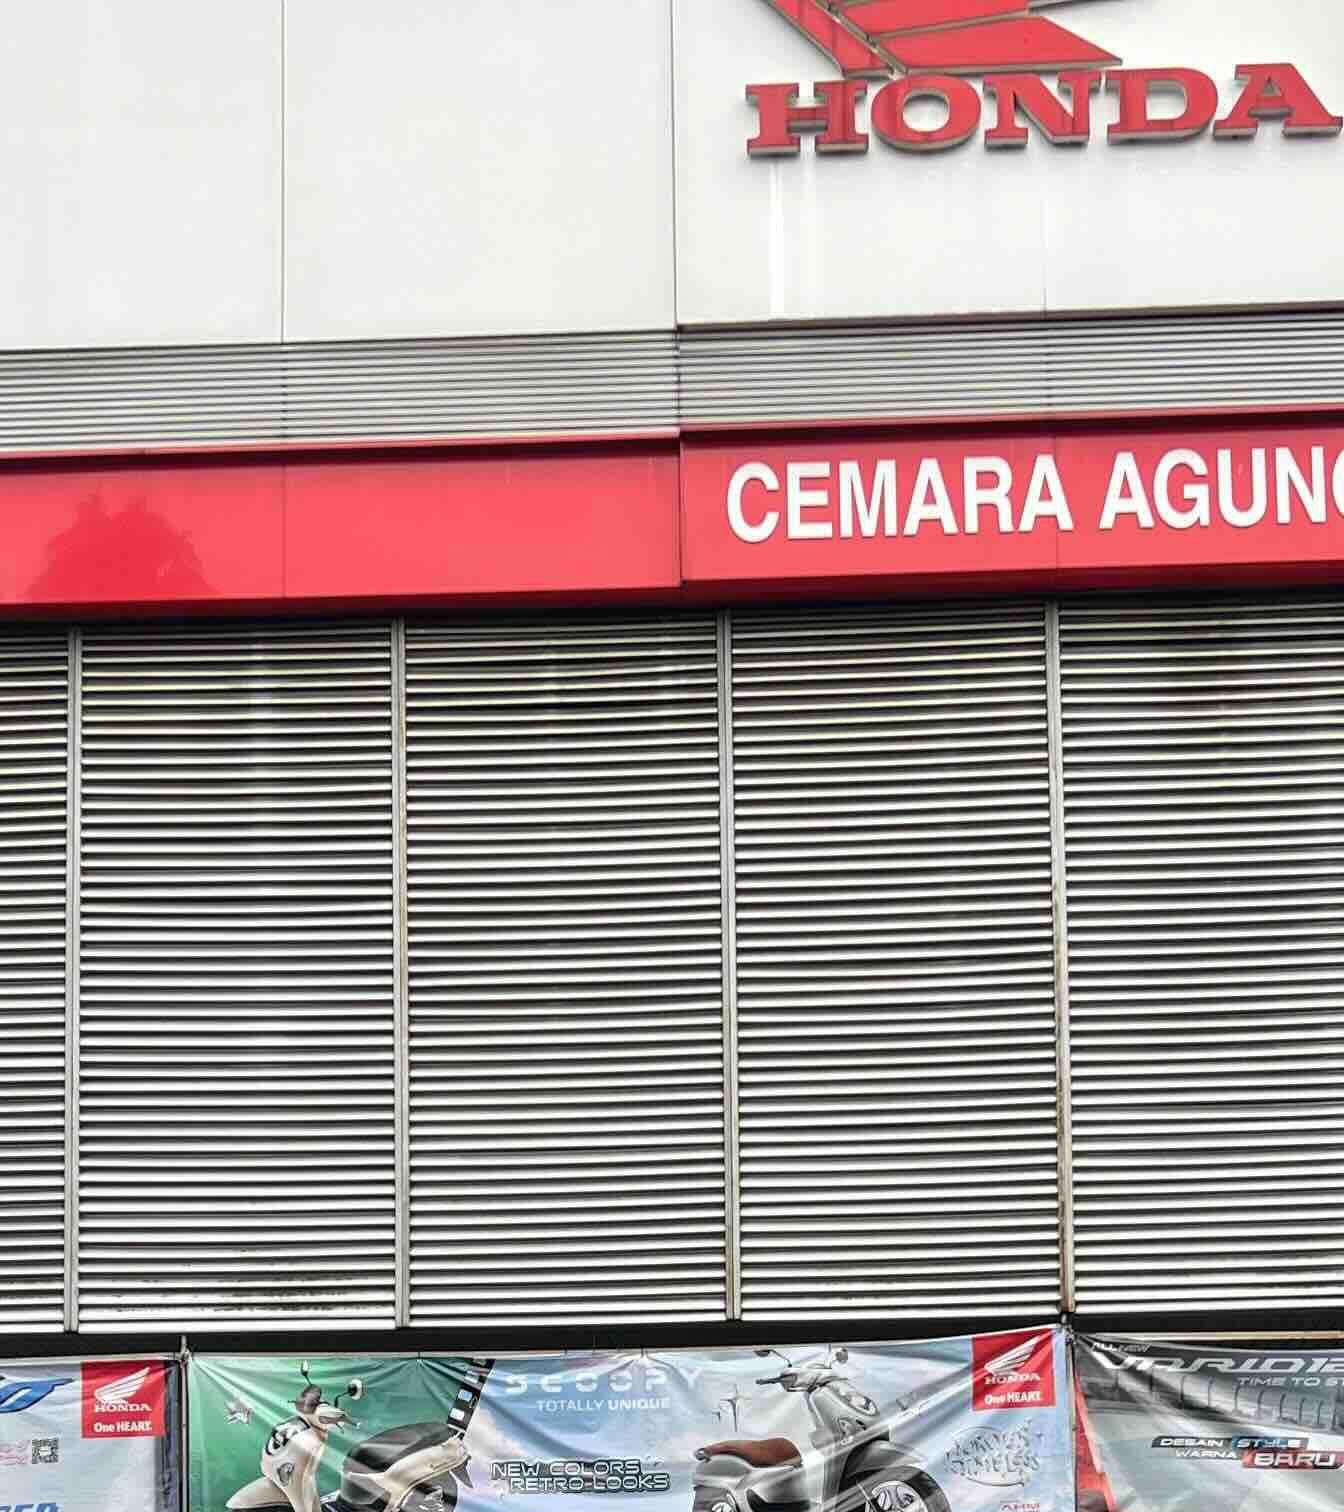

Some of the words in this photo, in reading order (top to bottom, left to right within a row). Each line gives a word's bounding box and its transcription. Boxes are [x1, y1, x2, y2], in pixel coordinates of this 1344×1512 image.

[745, 62, 1343, 156] HONDA
[726, 453, 1074, 544] CEMARA
[506, 1369, 705, 1392] SCOOPY
[984, 1373, 1041, 1385] HONDA
[1237, 1377, 1289, 1387] TIME
[1292, 1377, 1322, 1386] TO
[537, 1399, 602, 1412] TOTALLY
[609, 1398, 670, 1411] UNIQUE
[984, 1393, 1006, 1405] One
[94, 1402, 153, 1413] HONDA
[93, 1421, 115, 1434] One
[1160, 1438, 1224, 1447] DESAIN
[1236, 1438, 1302, 1448] STYLE
[1176, 1450, 1238, 1460] WARNA
[1254, 1453, 1336, 1466] BARU
[491, 1460, 542, 1477] NEW
[548, 1459, 641, 1476] COLORS
[511, 1476, 585, 1492] RETRO
[593, 1474, 671, 1491] LOOKS
